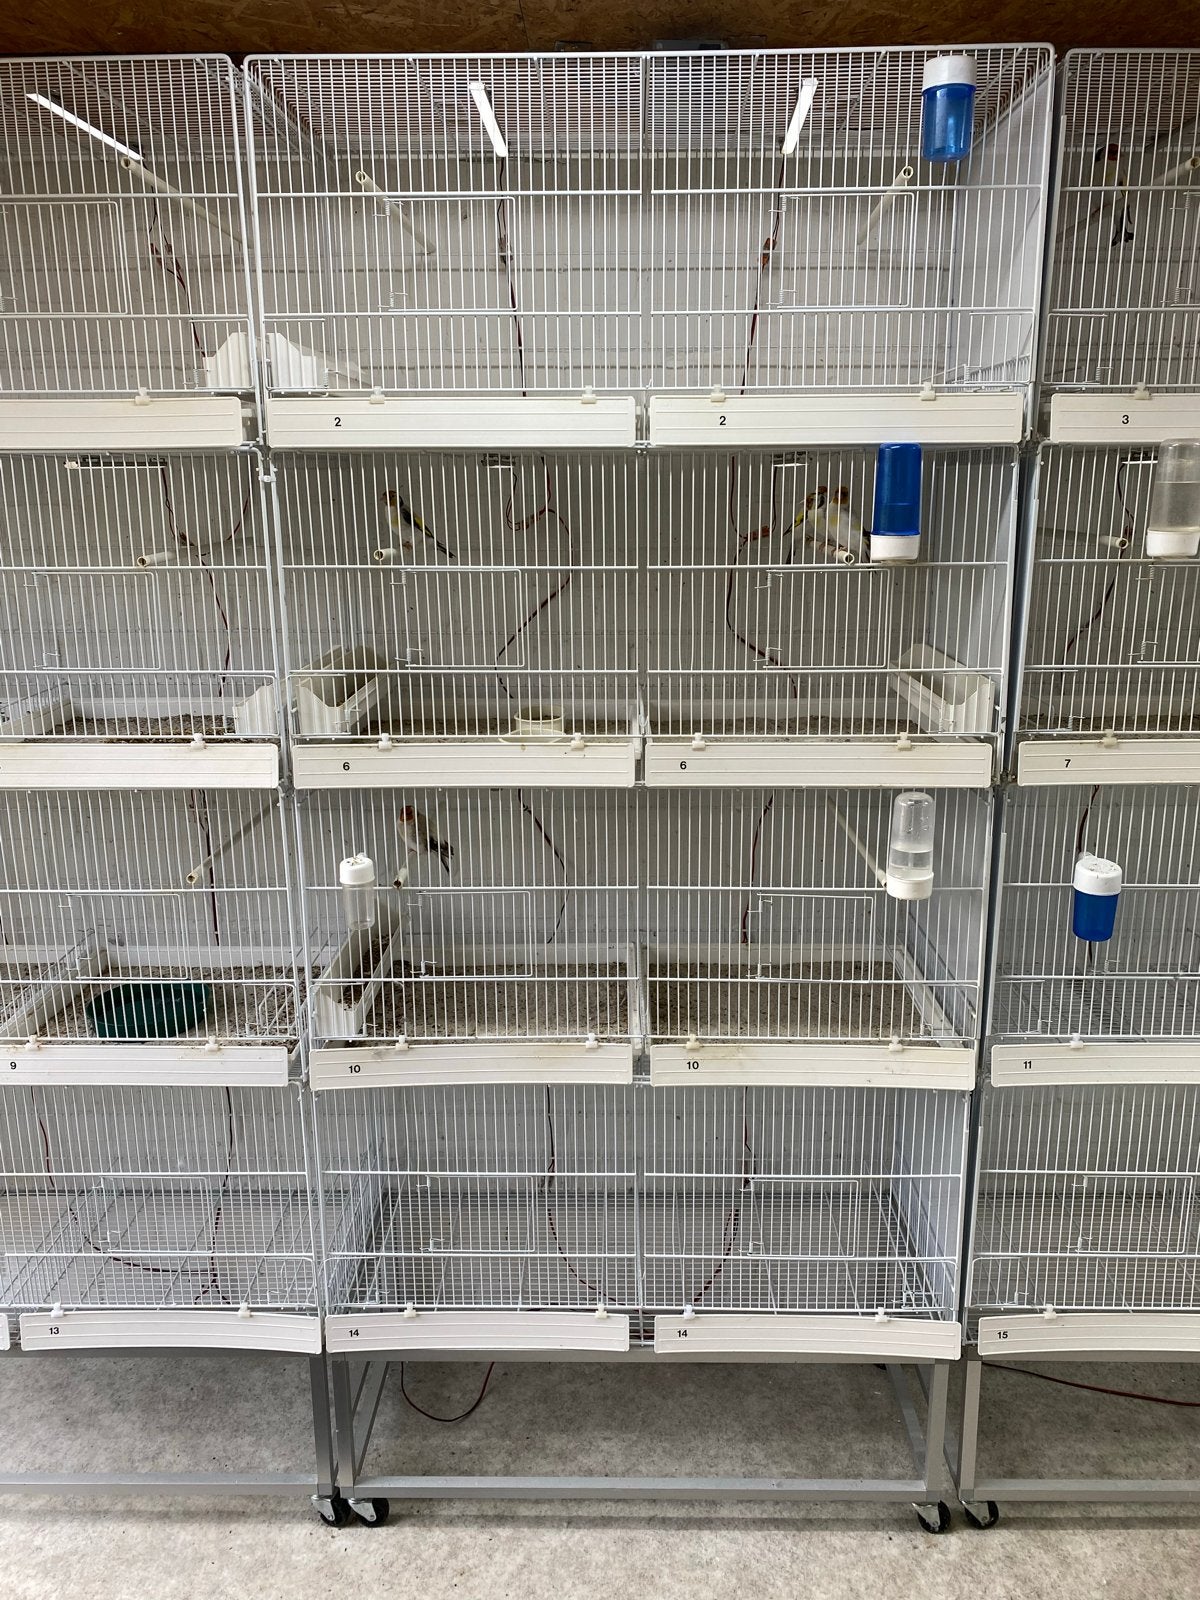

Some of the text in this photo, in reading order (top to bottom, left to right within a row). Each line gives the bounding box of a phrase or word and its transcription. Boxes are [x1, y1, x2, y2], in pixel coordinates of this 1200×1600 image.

[334, 416, 342, 427] 2
[719, 415, 727, 426] 2
[1121, 414, 1130, 425] 3
[342, 761, 351, 771] 6
[679, 760, 687, 770] 6
[1064, 758, 1072, 769] 7
[9, 1061, 17, 1070] 9
[348, 1064, 361, 1074] 10
[686, 1060, 700, 1070] 10
[1023, 1060, 1032, 1070] 11
[48, 1326, 60, 1335] 13
[348, 1328, 360, 1338] 14
[677, 1329, 688, 1338] 14
[997, 1330, 1009, 1339] 15
